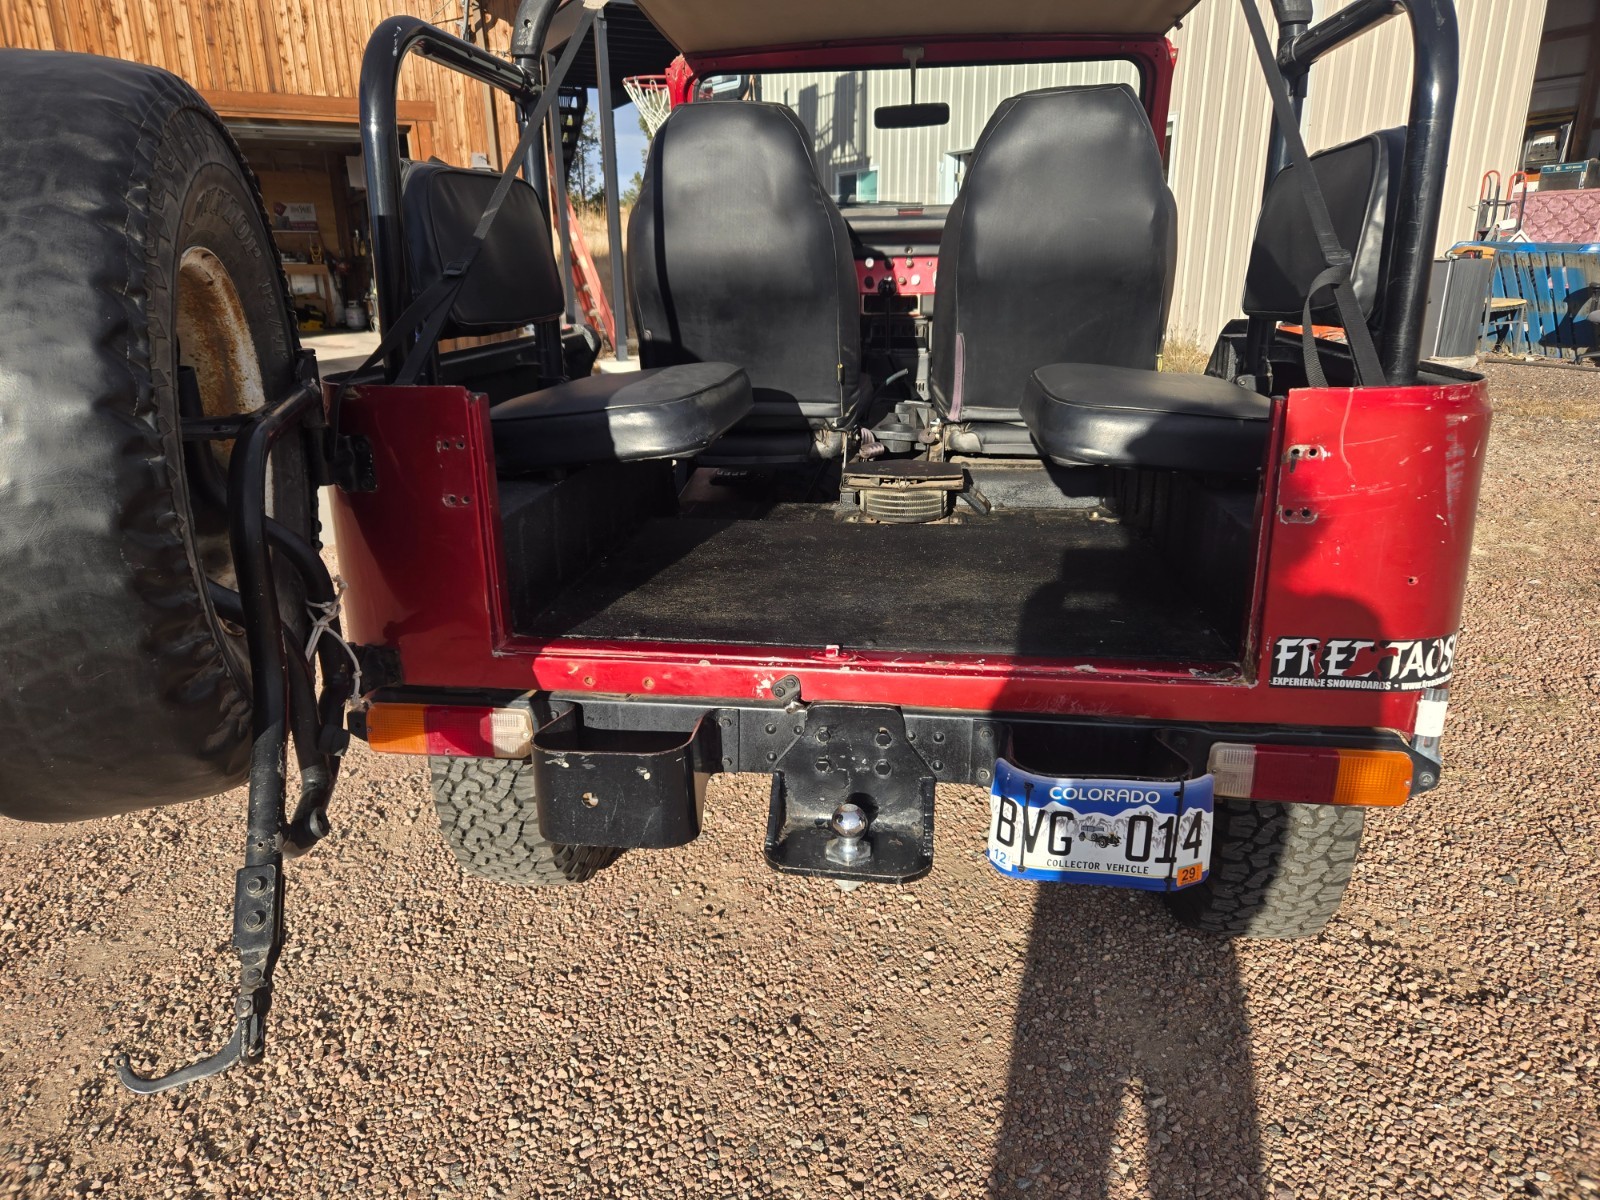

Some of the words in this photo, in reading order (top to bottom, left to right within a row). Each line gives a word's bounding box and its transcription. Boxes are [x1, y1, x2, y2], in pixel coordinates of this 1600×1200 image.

[1273, 677, 1326, 688] EXPERIENCE
[1326, 678, 1391, 690] SNOWBOARDS
[1049, 786, 1161, 805] COLORADO
[996, 796, 1075, 857] BVG
[1124, 810, 1204, 865] 014
[994, 848, 1007, 865] 12
[1046, 858, 1100, 870] COLLECTOR
[1106, 863, 1149, 875] VEHICLE
[1181, 867, 1196, 881] 29
